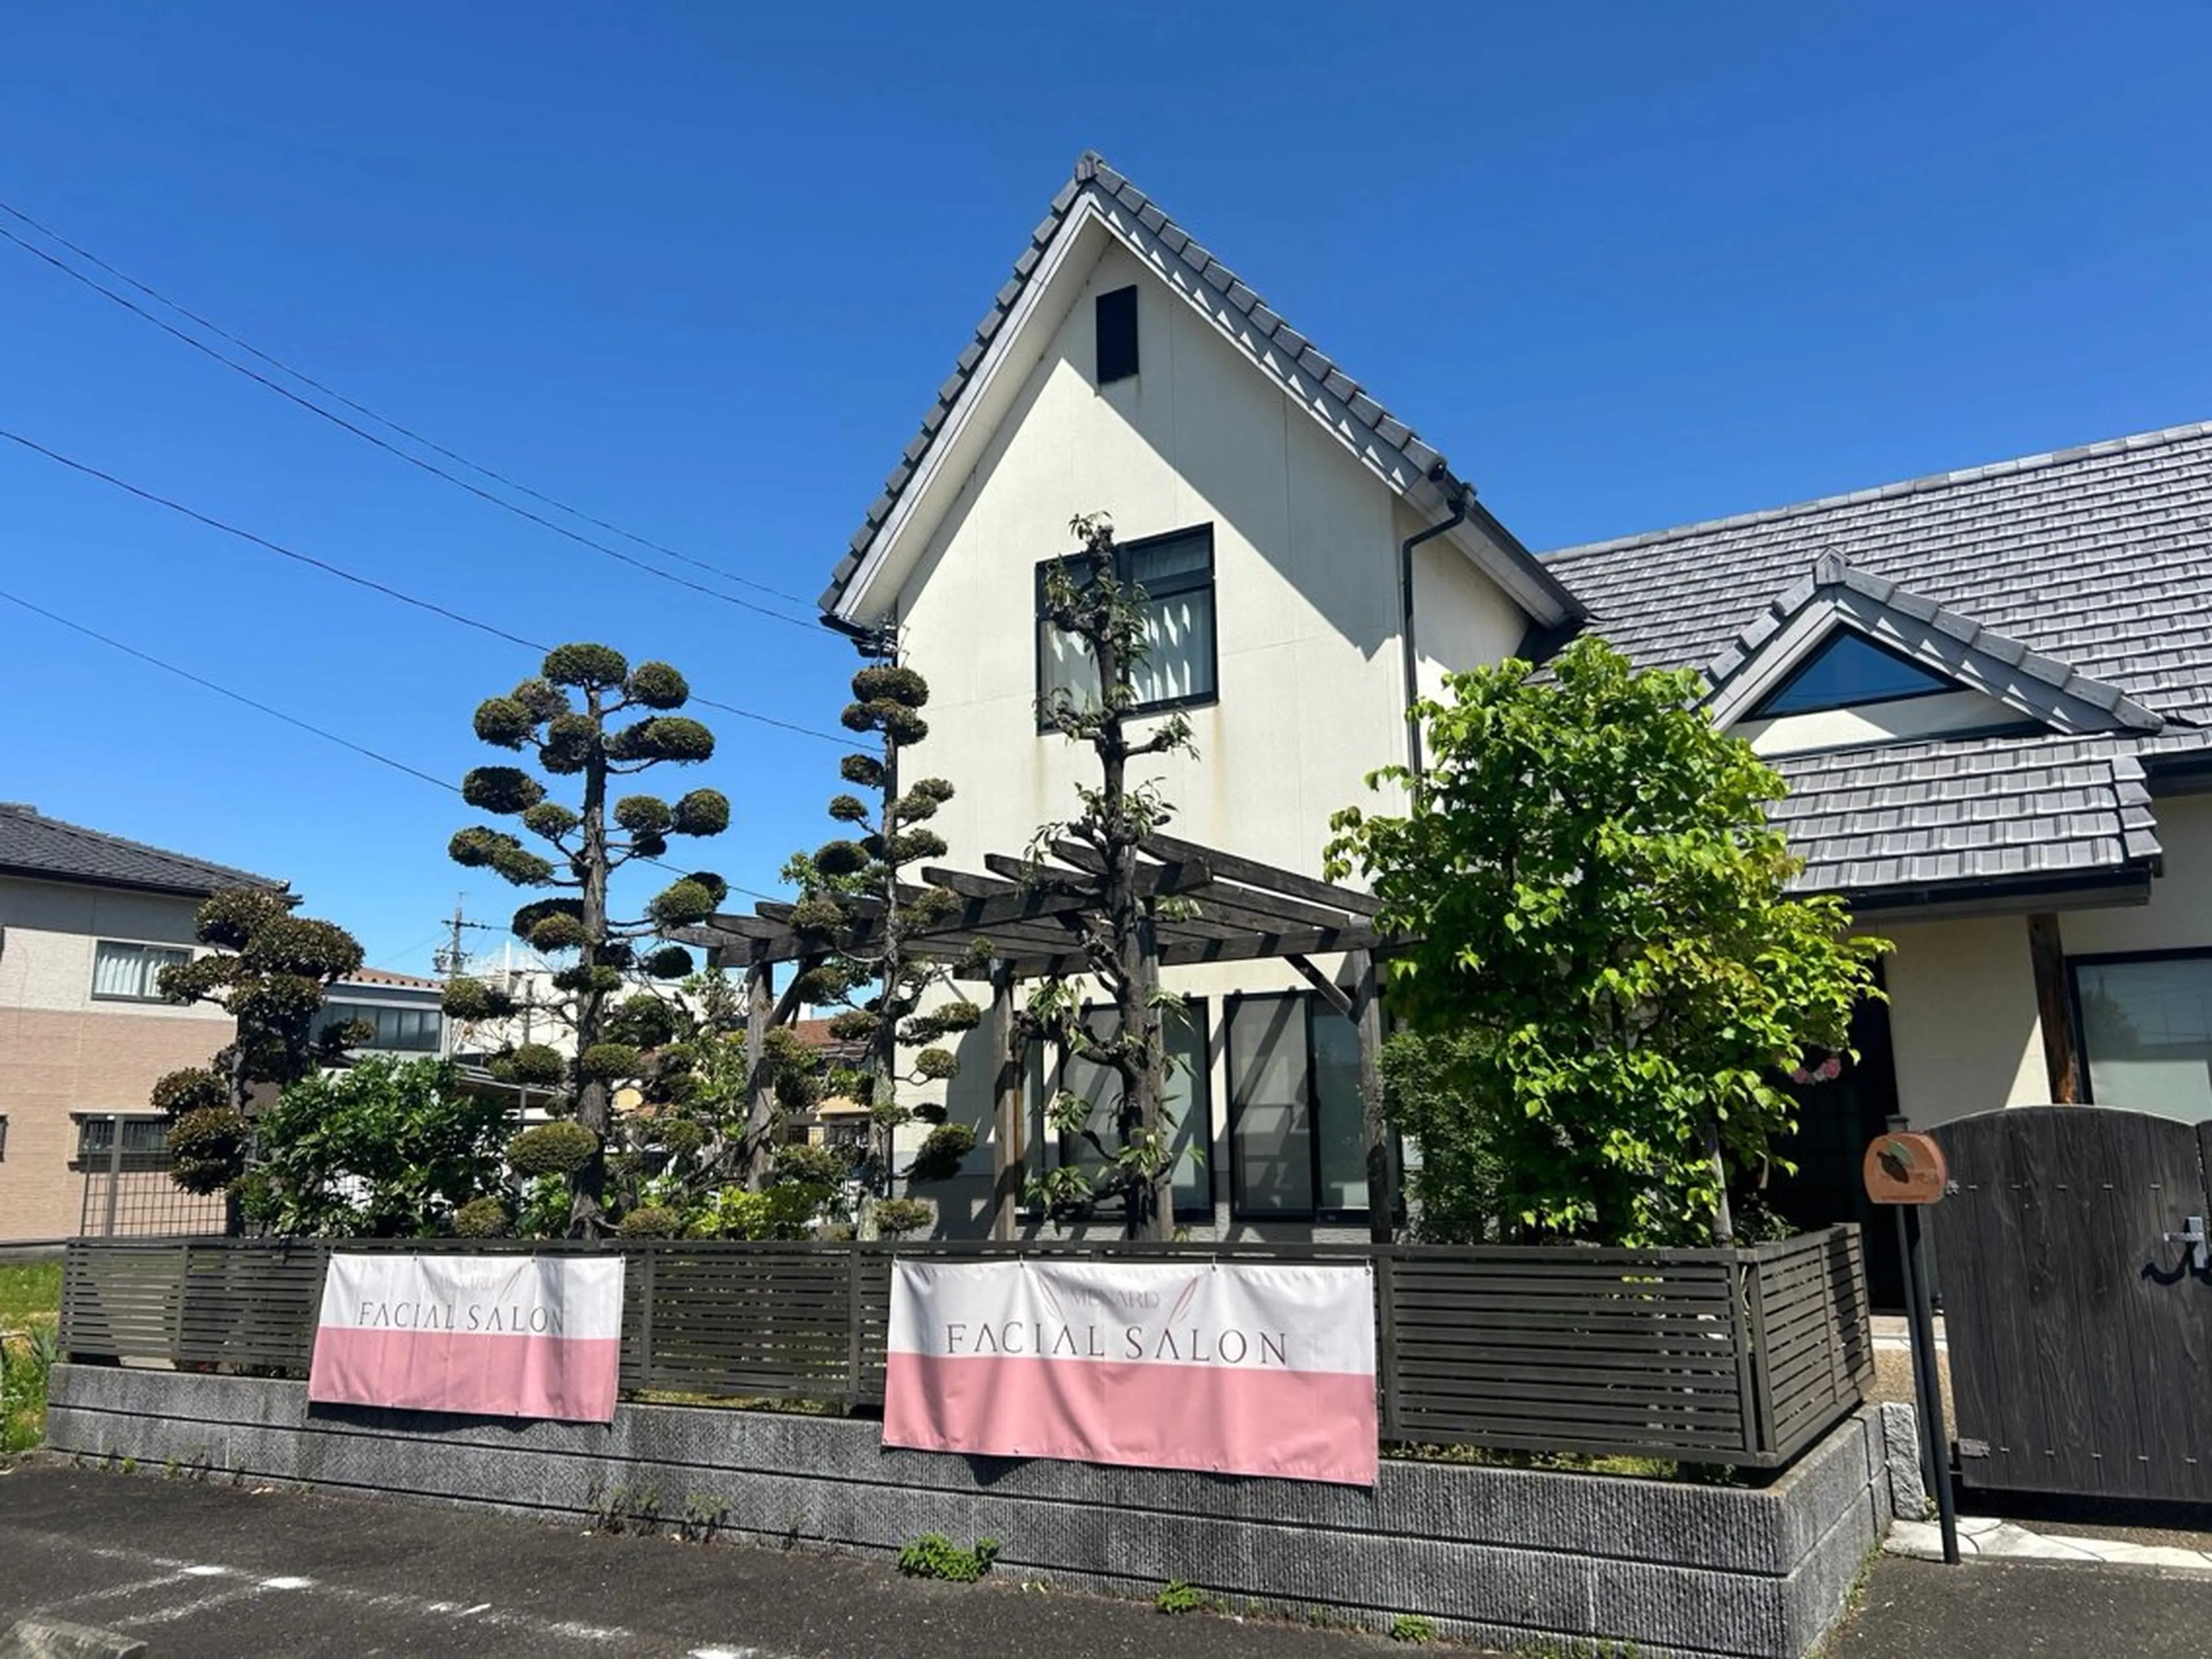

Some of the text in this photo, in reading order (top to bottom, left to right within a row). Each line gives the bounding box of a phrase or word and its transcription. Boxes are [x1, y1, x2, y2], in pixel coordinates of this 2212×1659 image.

[359, 1302, 563, 1332] FACIAL SALON
[948, 1323, 1287, 1365] FACIAL SALON
